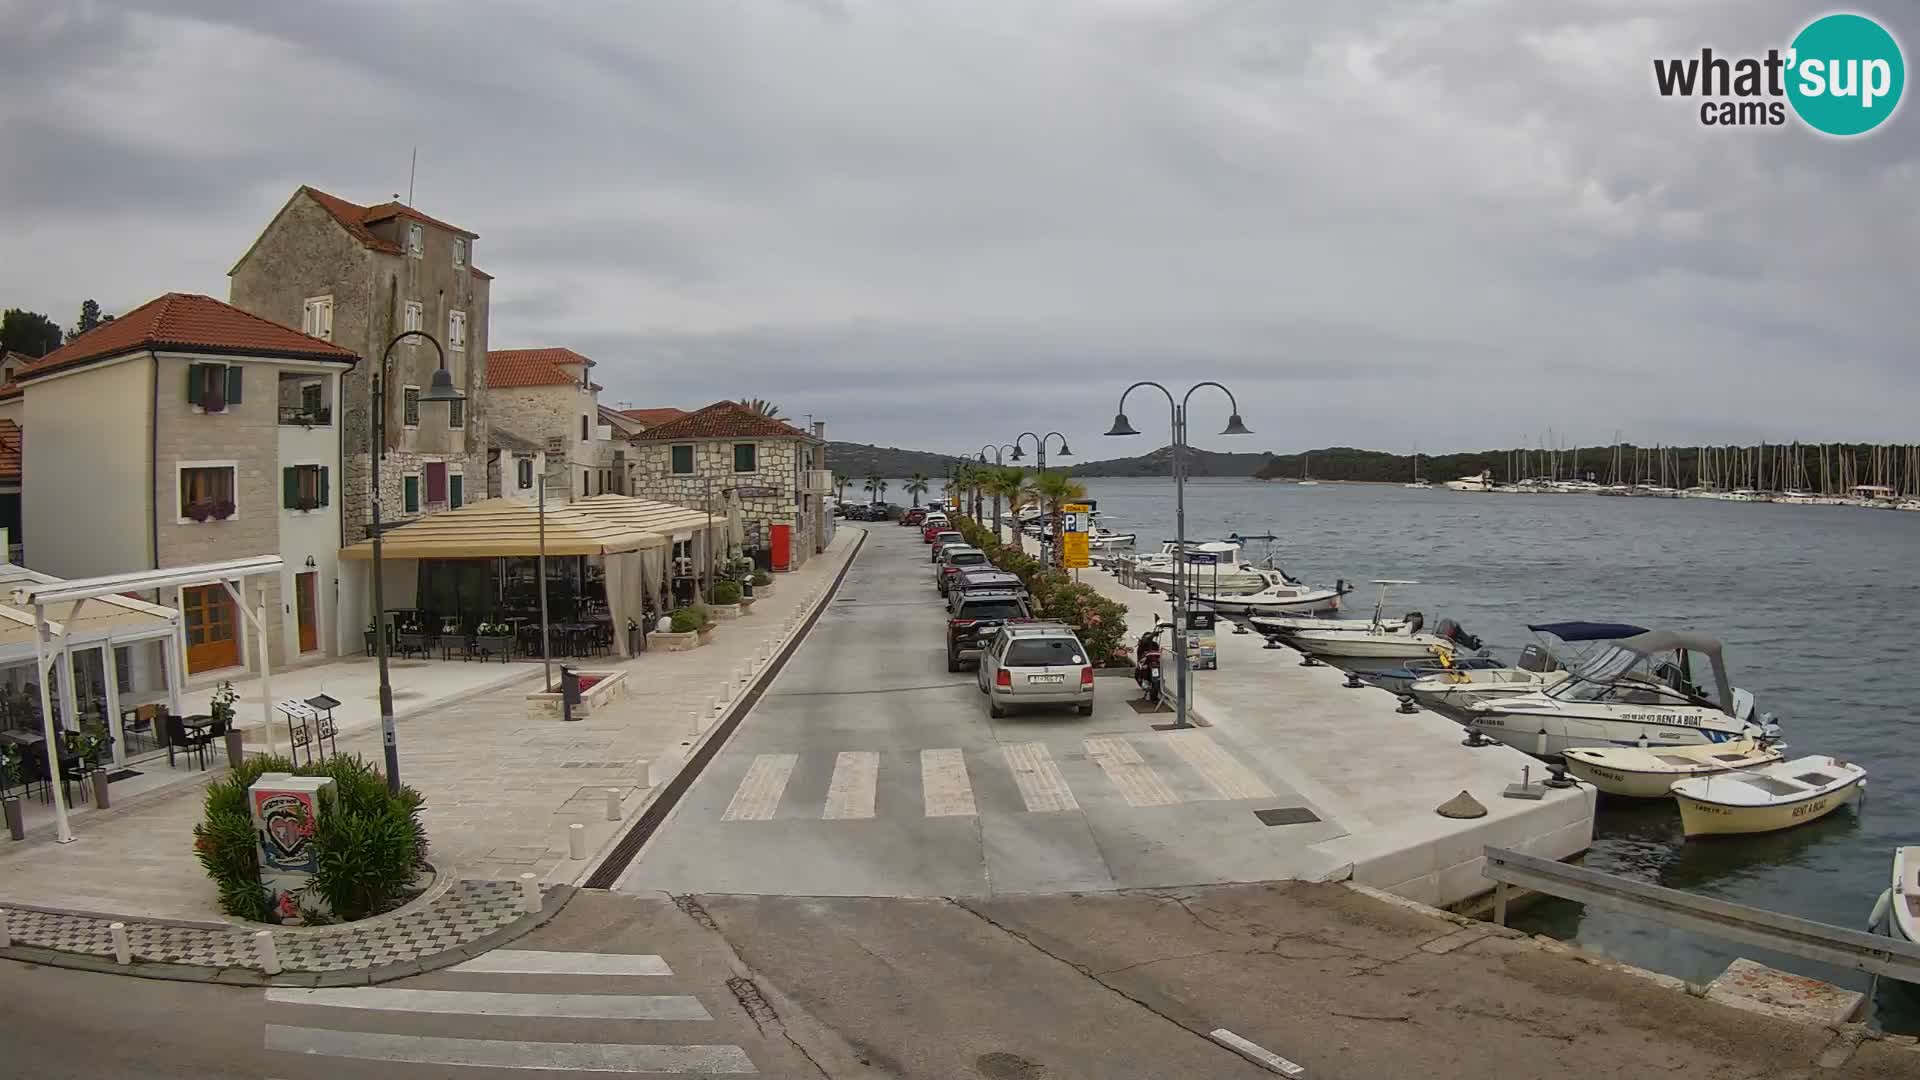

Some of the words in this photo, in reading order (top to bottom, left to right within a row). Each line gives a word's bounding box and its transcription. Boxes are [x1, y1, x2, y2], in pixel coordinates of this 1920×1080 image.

[1065, 514, 1076, 531] P
[1656, 713, 1676, 725] RENT
[1676, 715, 1683, 725] A
[1683, 715, 1703, 727] BOAT
